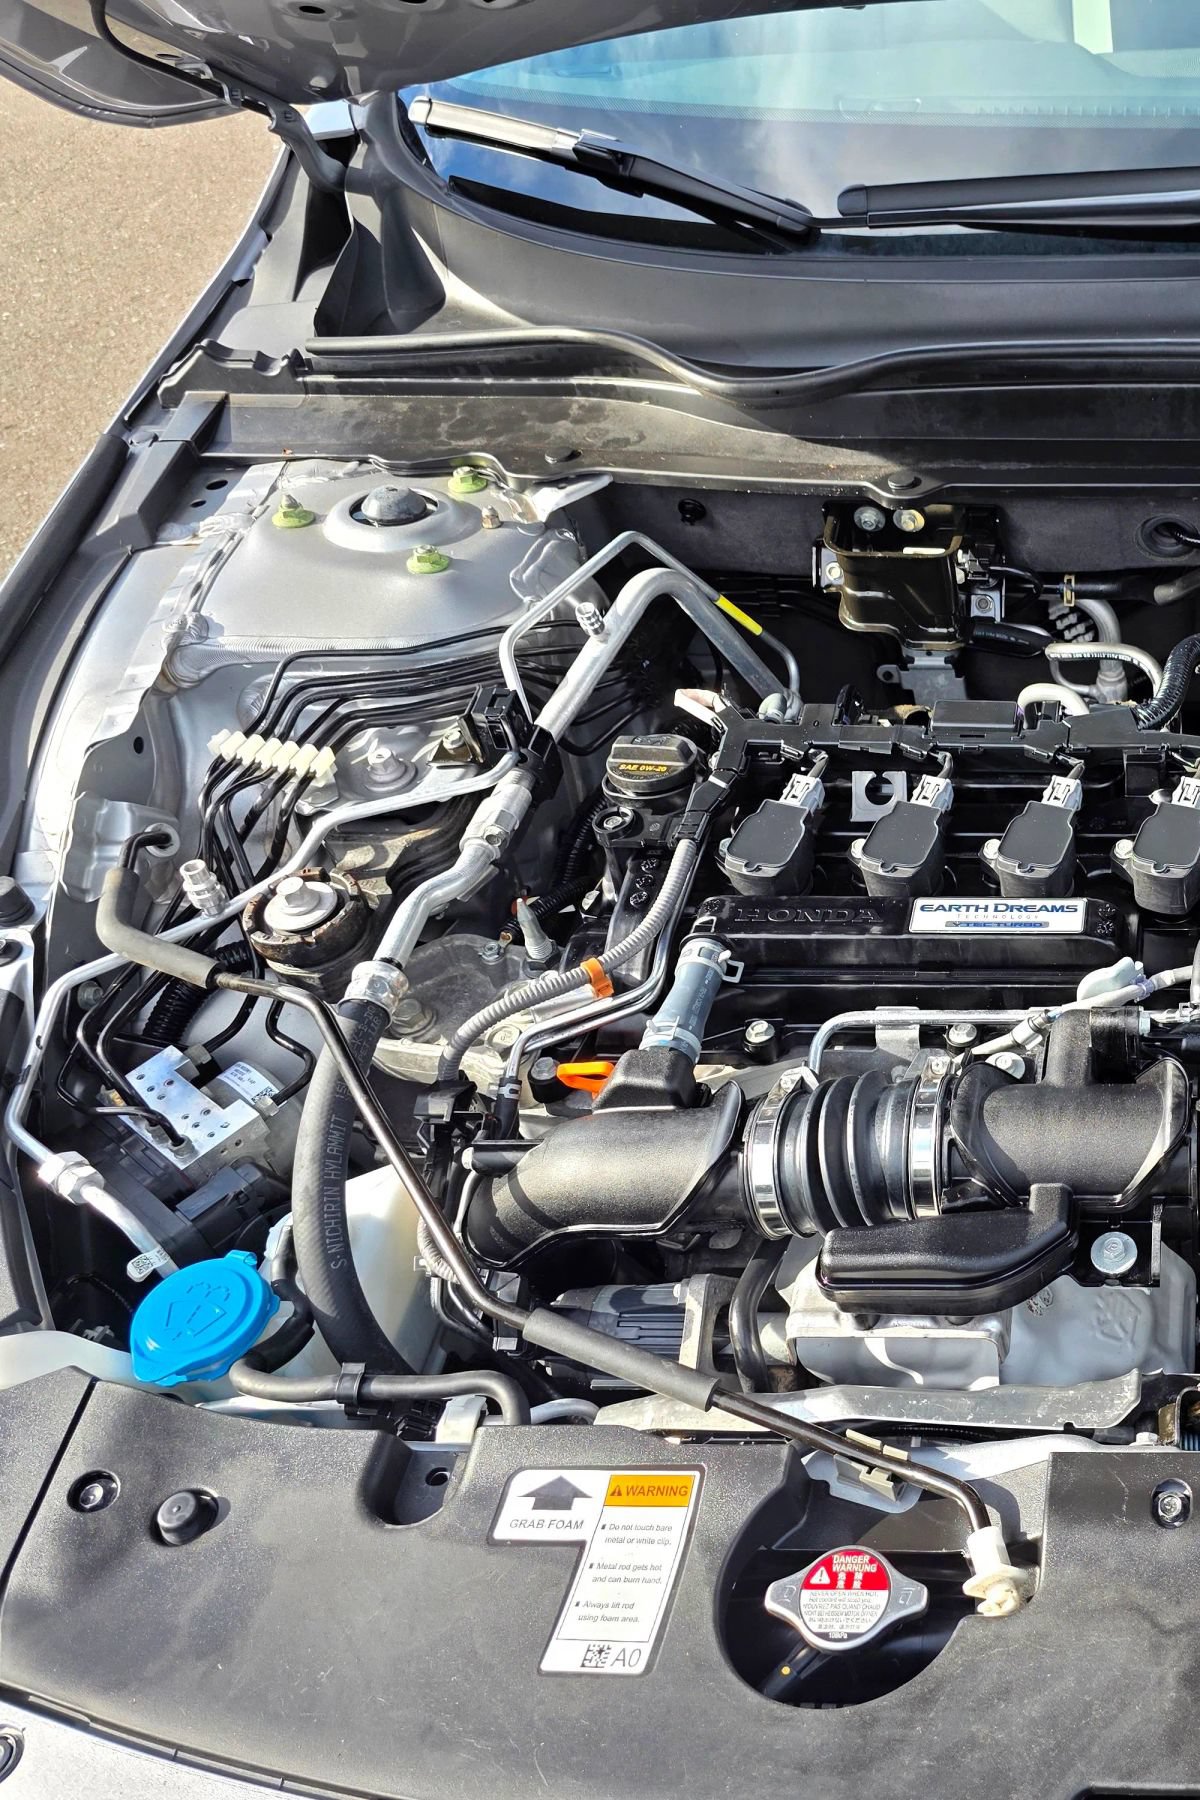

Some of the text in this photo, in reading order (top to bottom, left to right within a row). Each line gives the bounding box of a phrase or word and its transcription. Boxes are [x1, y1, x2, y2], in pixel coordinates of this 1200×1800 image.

[919, 903, 1078, 912] EARTH DREAMS
[734, 908, 886, 923] HONDA
[324, 1113, 348, 1181] HYLAMMIT
[626, 1485, 688, 1497] WARNING
[510, 1518, 584, 1530] GRAB FOAM
[657, 1538, 672, 1546] clip.
[832, 1554, 870, 1564] DANGER
[632, 1564, 648, 1572] gets
[832, 1564, 878, 1572] WARNUNG
[582, 1600, 609, 1610] Always
